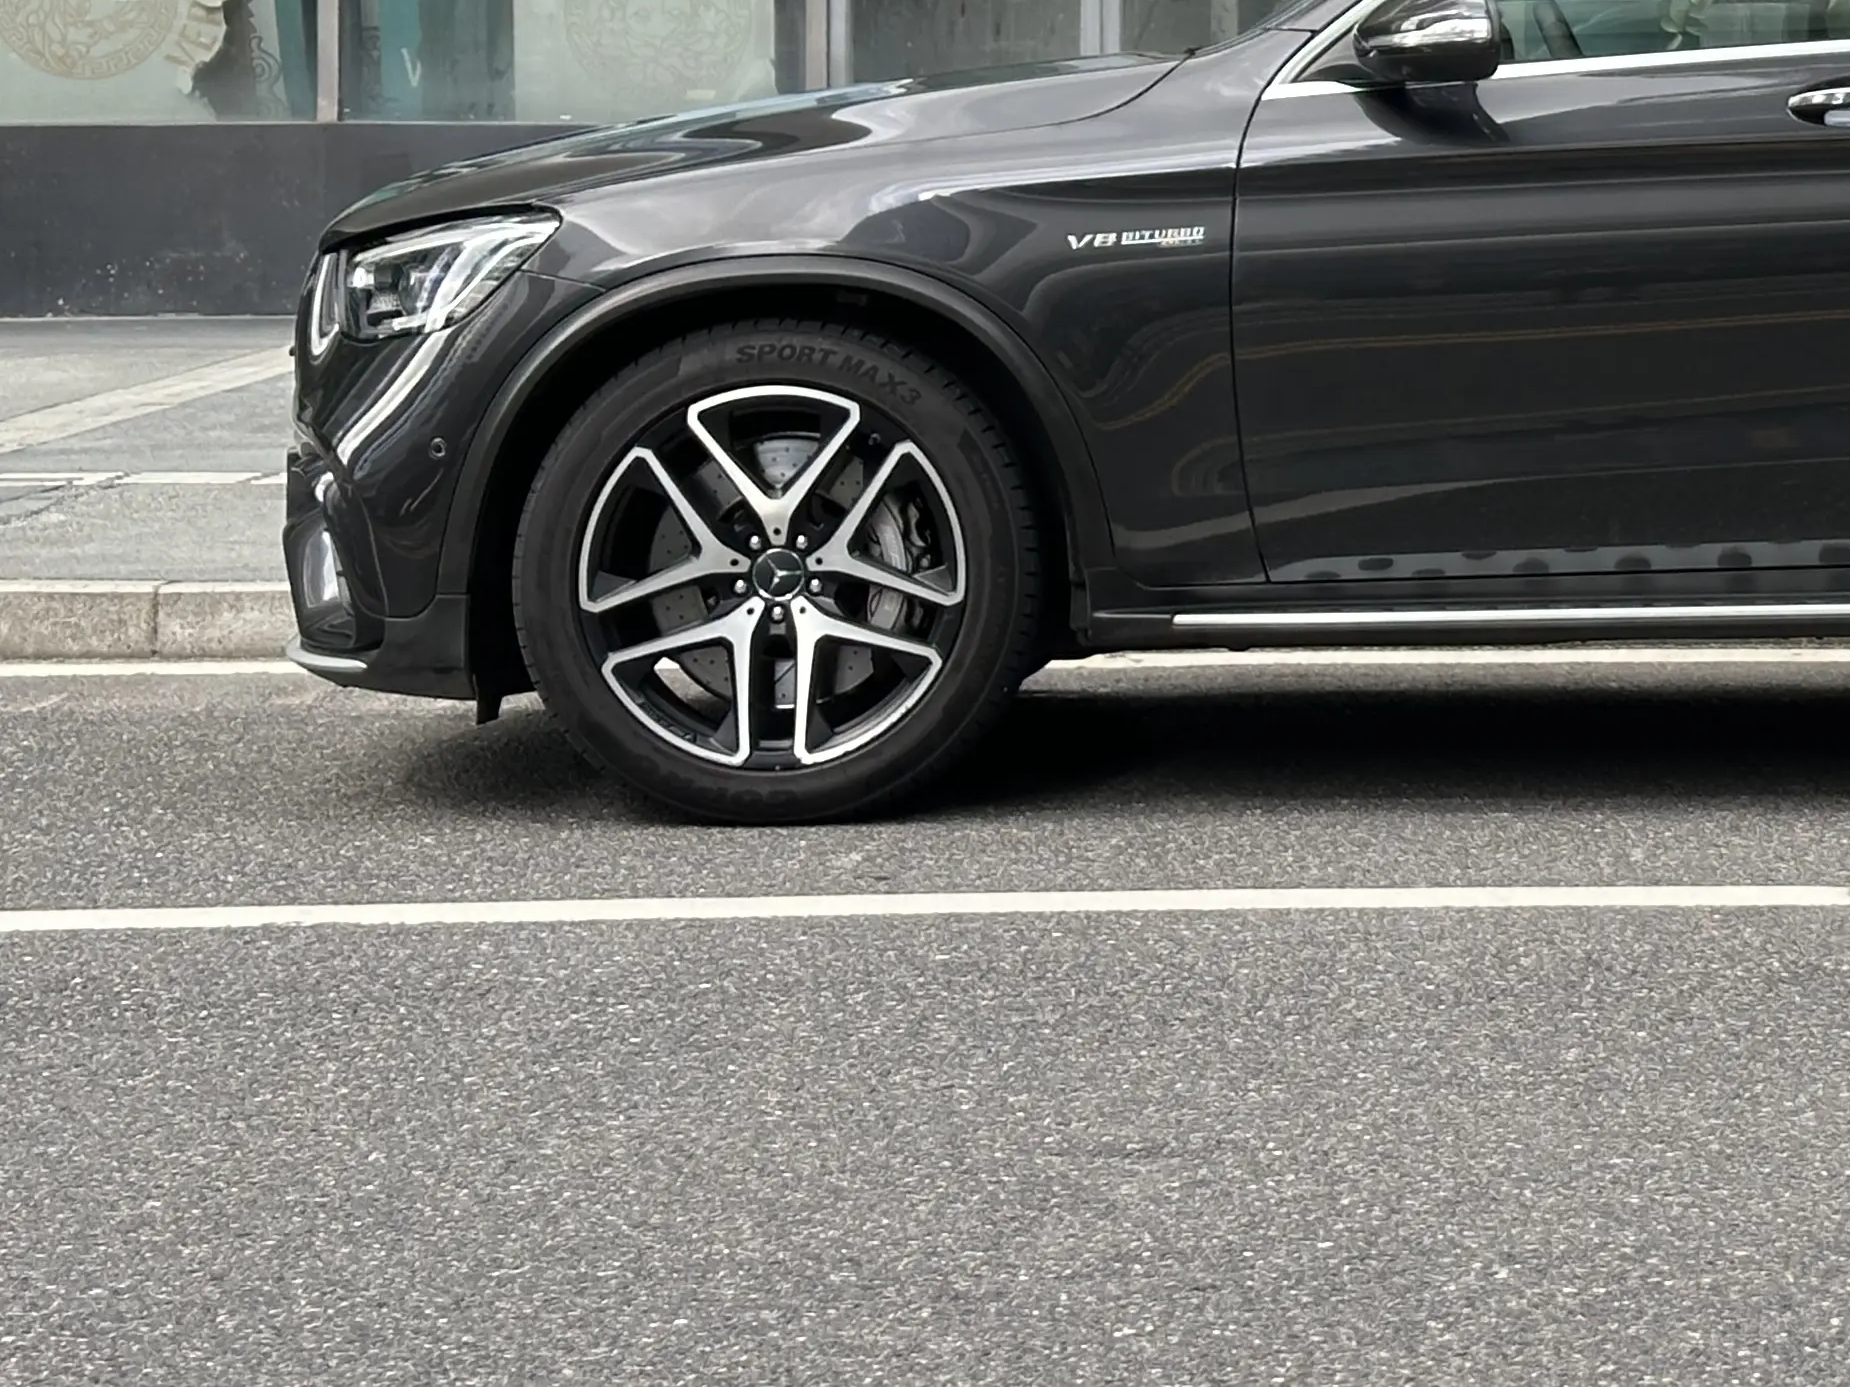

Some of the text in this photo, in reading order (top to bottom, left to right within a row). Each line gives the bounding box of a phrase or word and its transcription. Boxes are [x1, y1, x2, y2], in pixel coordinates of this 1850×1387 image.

[1067, 226, 1205, 250] V8 BITURBO
[735, 343, 837, 365] SPORT
